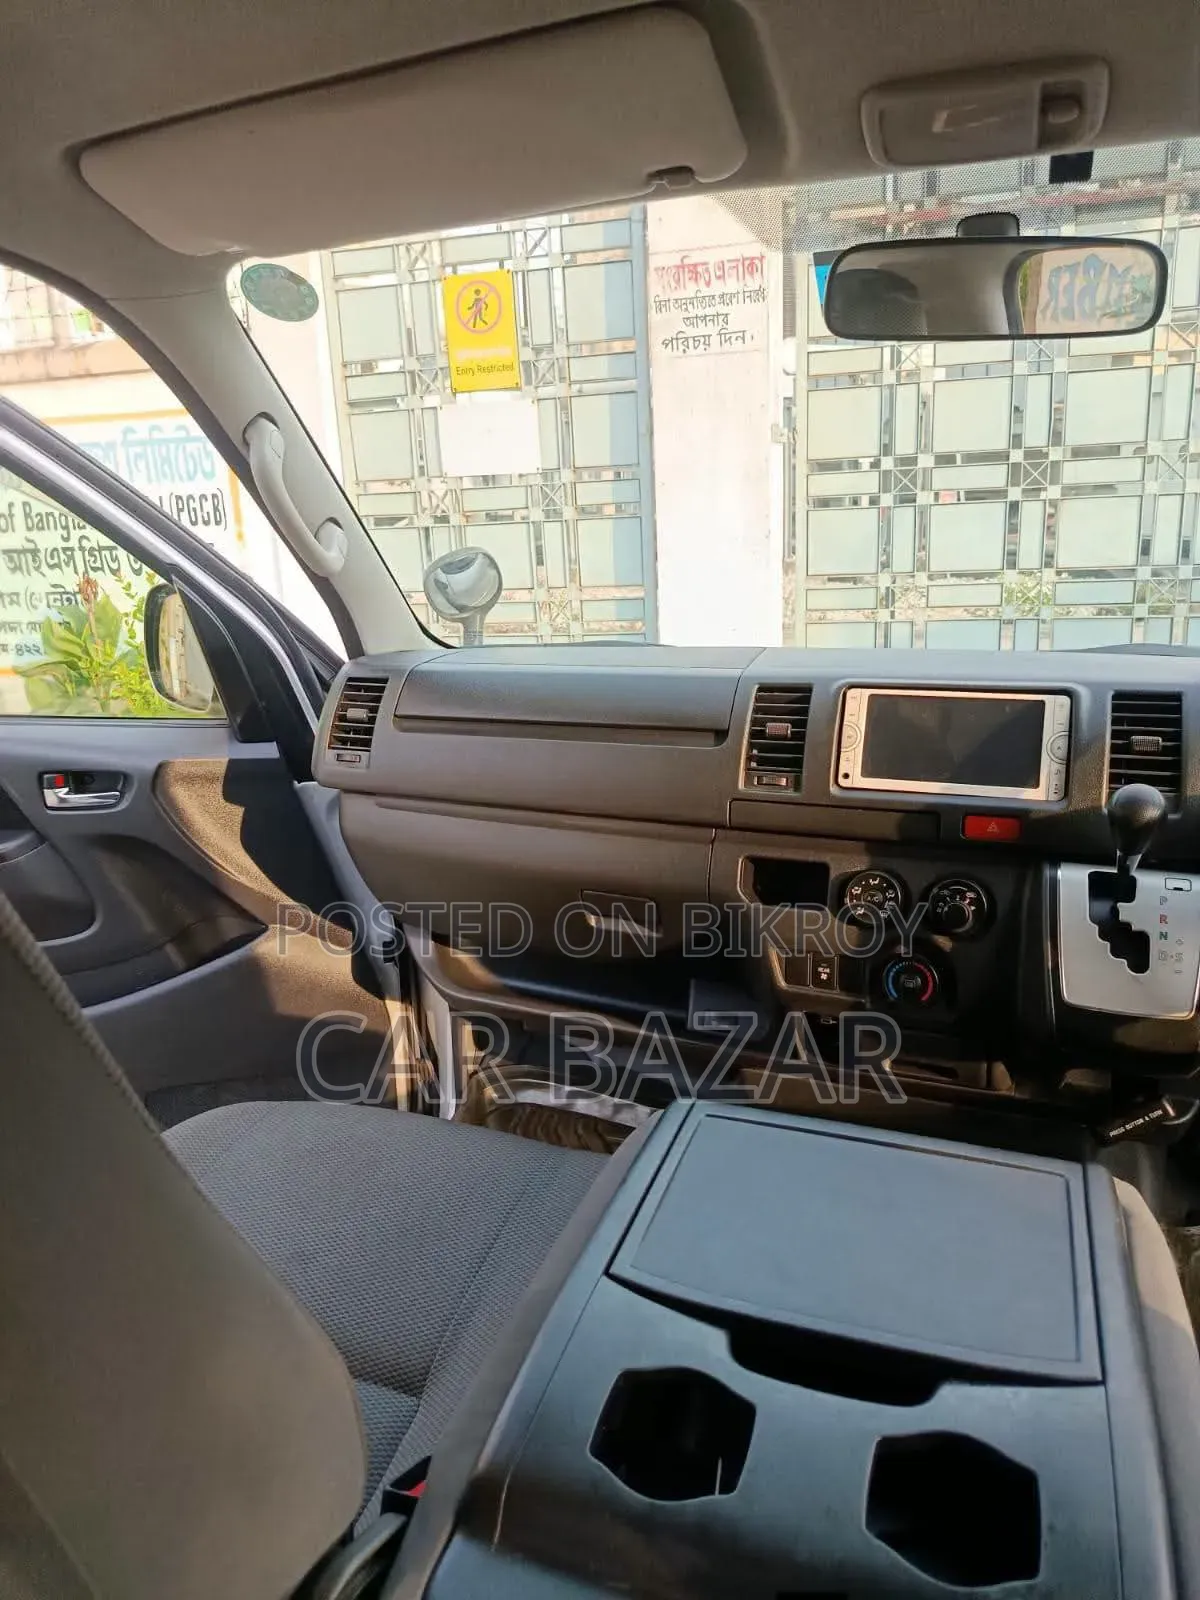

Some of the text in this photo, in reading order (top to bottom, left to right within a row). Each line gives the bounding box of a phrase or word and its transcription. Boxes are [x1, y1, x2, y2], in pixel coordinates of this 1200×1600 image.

[713, 252, 766, 287] এলাকা
[682, 311, 731, 329] আপনার
[661, 331, 712, 354] পরিচয়
[477, 361, 514, 374] Restricted
[120, 424, 217, 483] লিমিটেড
[169, 487, 228, 532] (PGCB)
[1160, 914, 1168, 924] R
[1160, 931, 1168, 940] N
